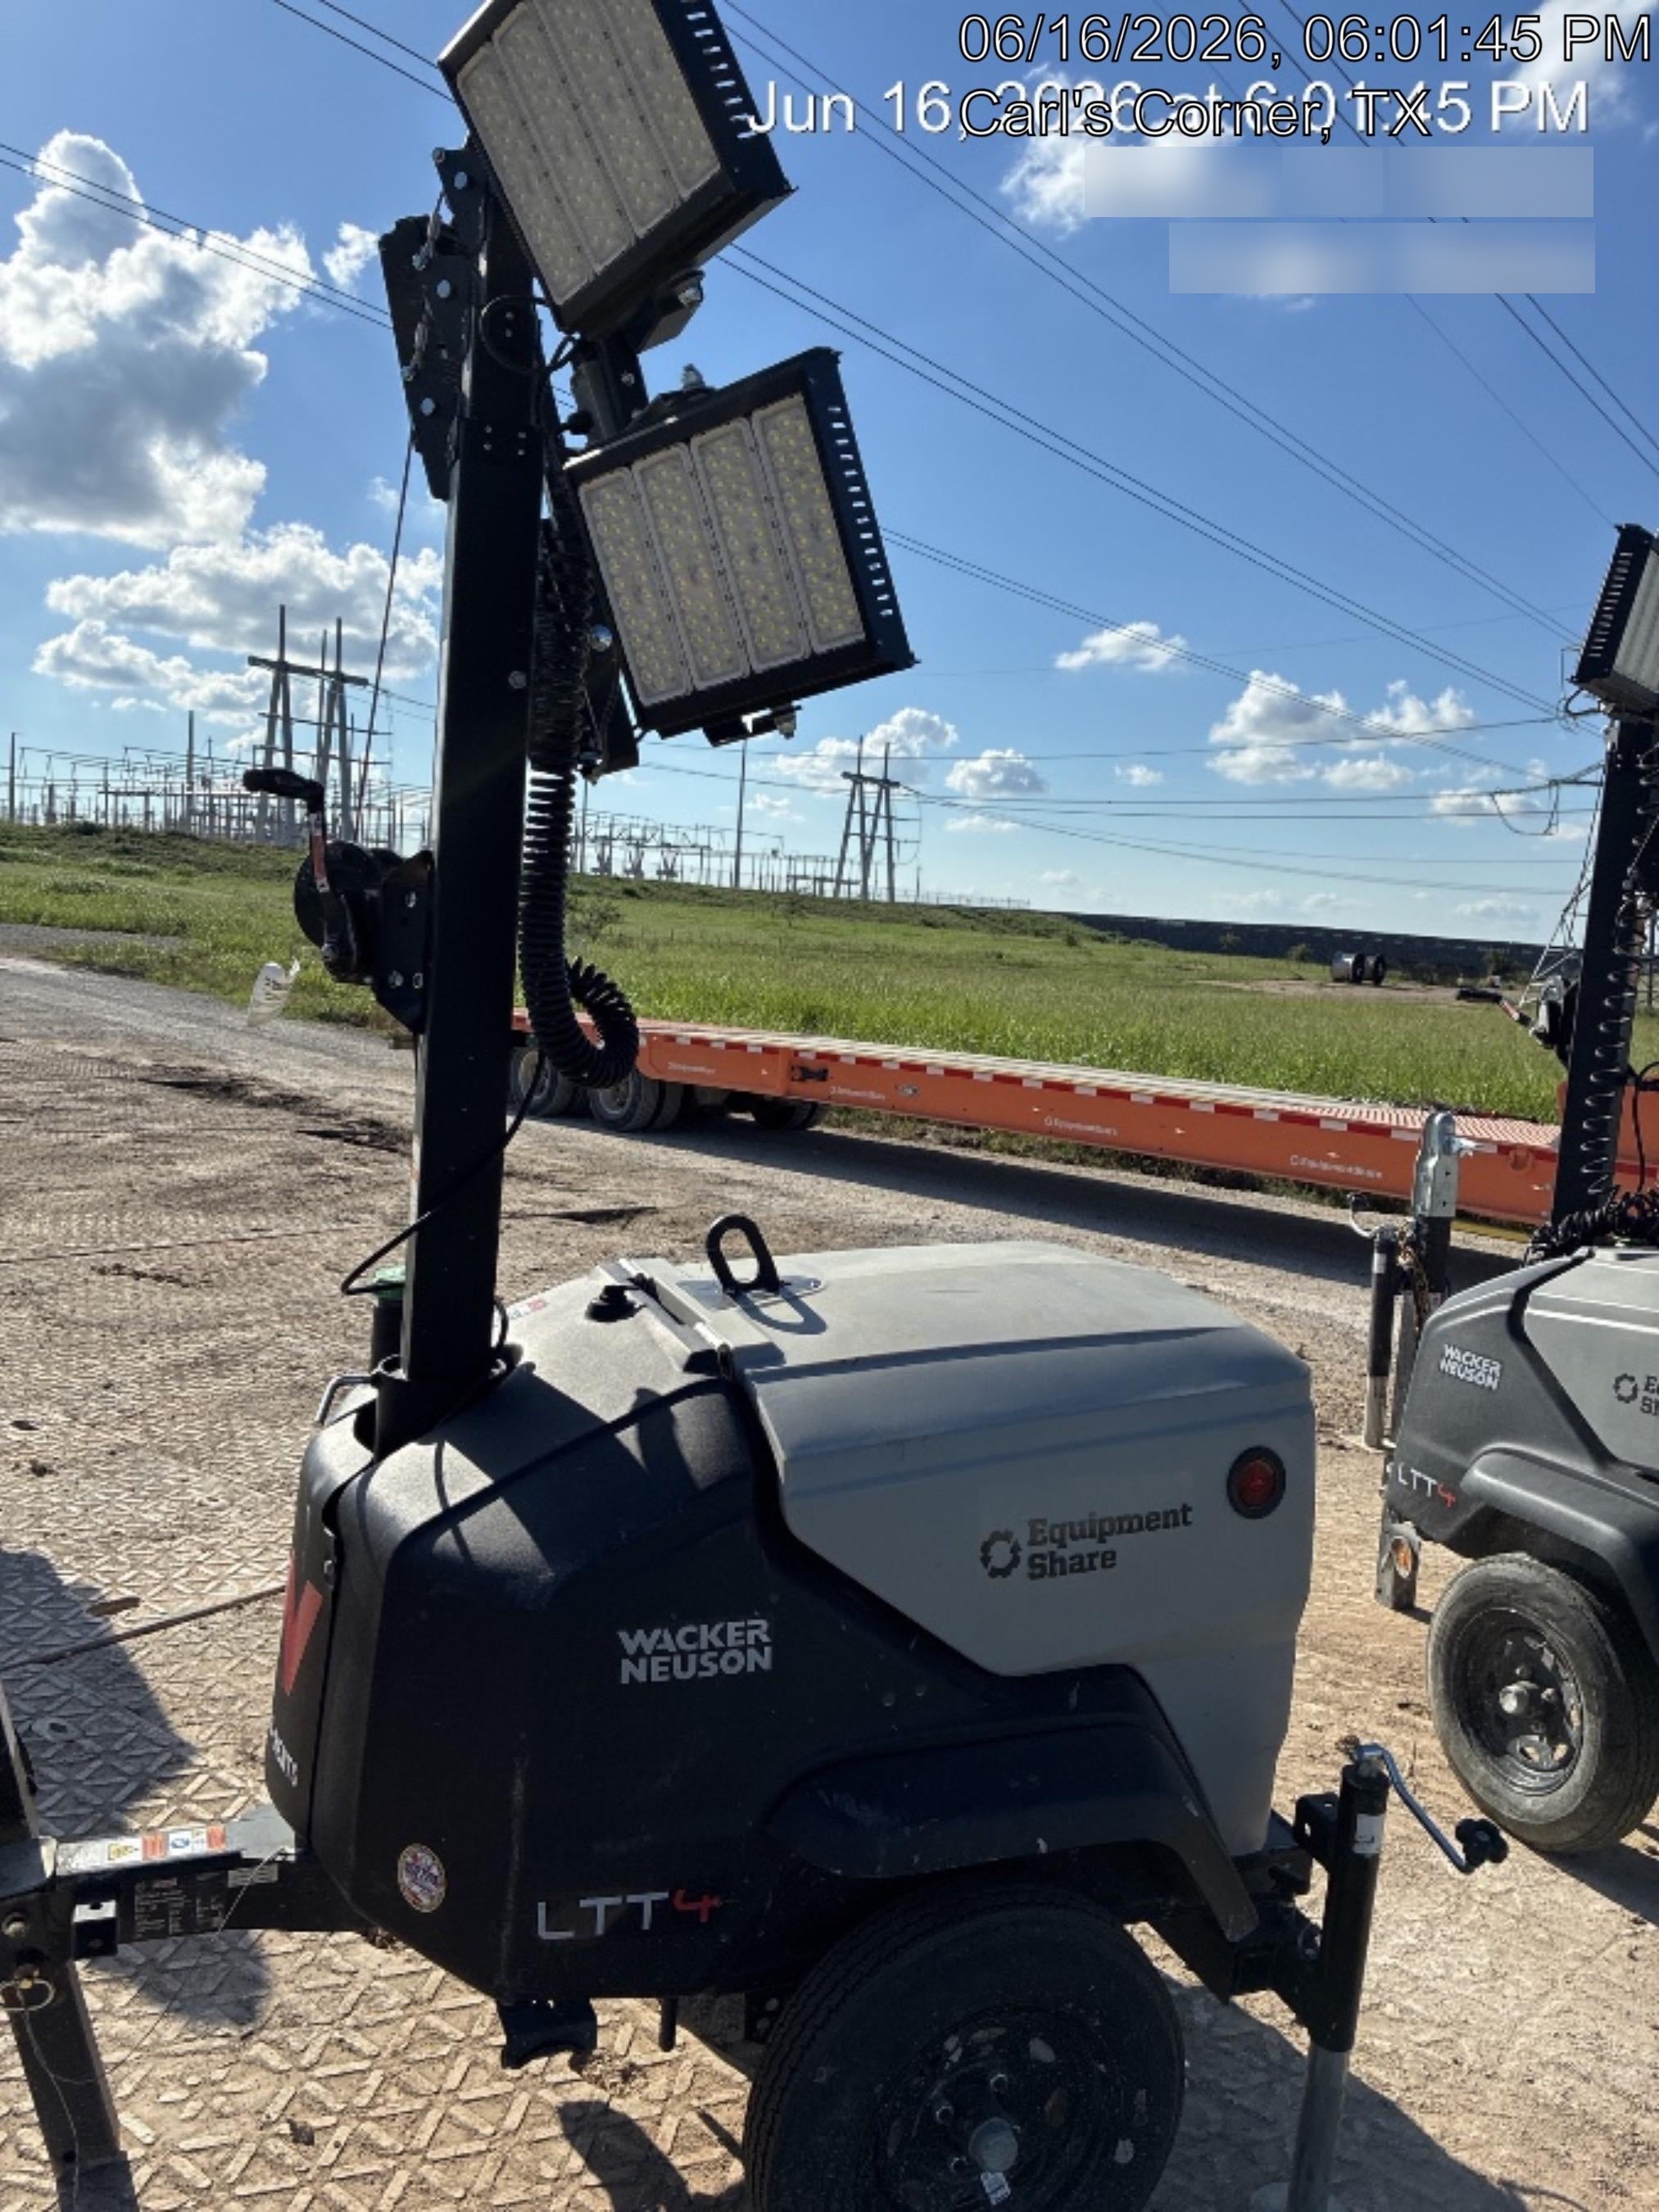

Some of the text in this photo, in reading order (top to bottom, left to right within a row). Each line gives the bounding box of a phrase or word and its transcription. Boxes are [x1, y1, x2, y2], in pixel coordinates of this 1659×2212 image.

[1439, 1357, 1499, 1391] NEUSON
[1444, 1344, 1501, 1378] WACKER
[1397, 1462, 1456, 1508] LTT4
[1027, 1503, 1193, 1549] Equipment
[1027, 1548, 1117, 1580] Share
[617, 1619, 773, 1656] WACKER
[620, 1646, 773, 1684] NEUSON
[537, 1888, 723, 1941] LTT4
